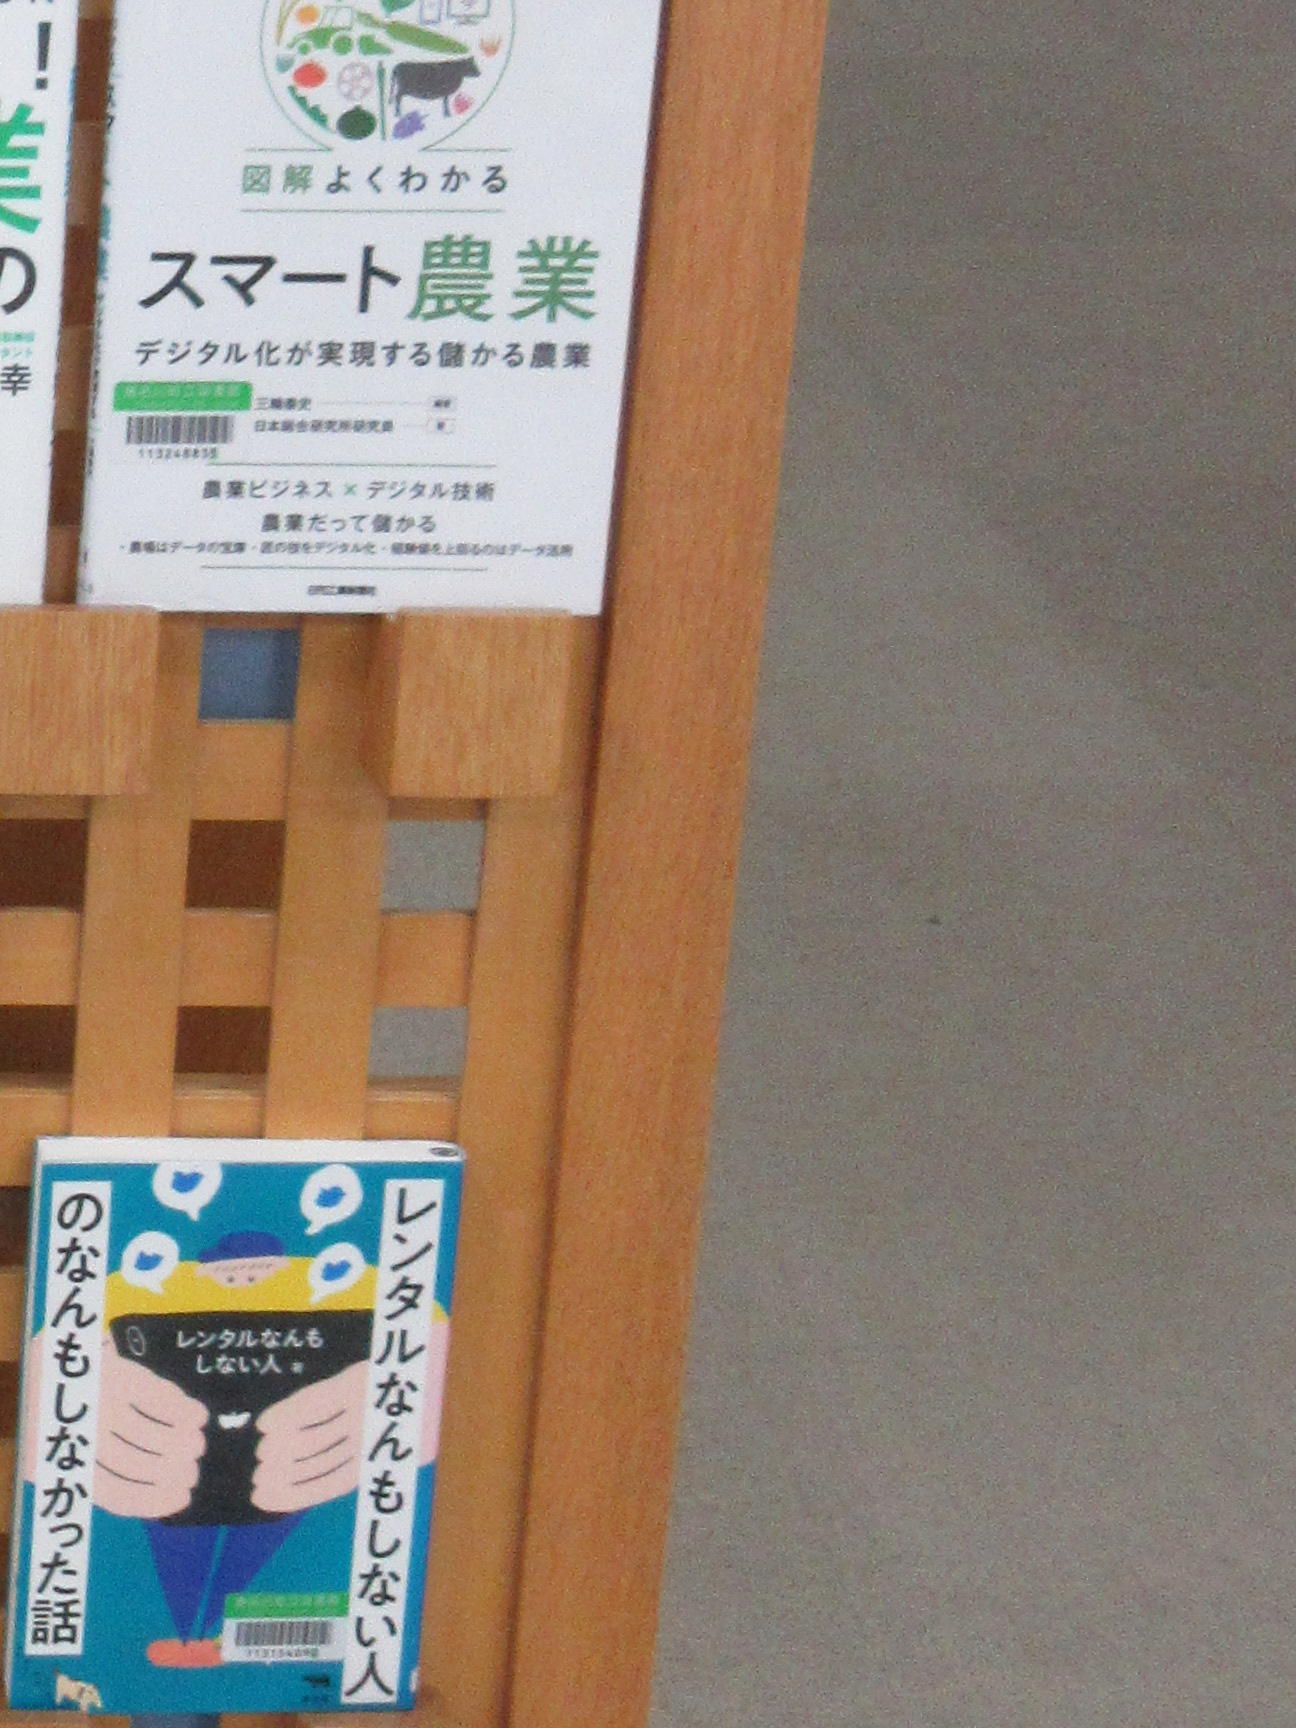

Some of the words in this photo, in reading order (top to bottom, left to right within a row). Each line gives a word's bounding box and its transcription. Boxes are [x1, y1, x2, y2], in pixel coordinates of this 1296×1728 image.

[241, 163, 508, 195] 図解よくわかる
[138, 234, 602, 325] スマート農業
[134, 340, 592, 370] デジタル化が実現する儲かる農業
[261, 511, 437, 535] 農業だって儲かる
[177, 1327, 324, 1350] レンタルなんも
[196, 1354, 283, 1374] しない人
[30, 1192, 104, 1647] のなんもしなかった話
[345, 1188, 437, 1698] レンタルなんもしない人
